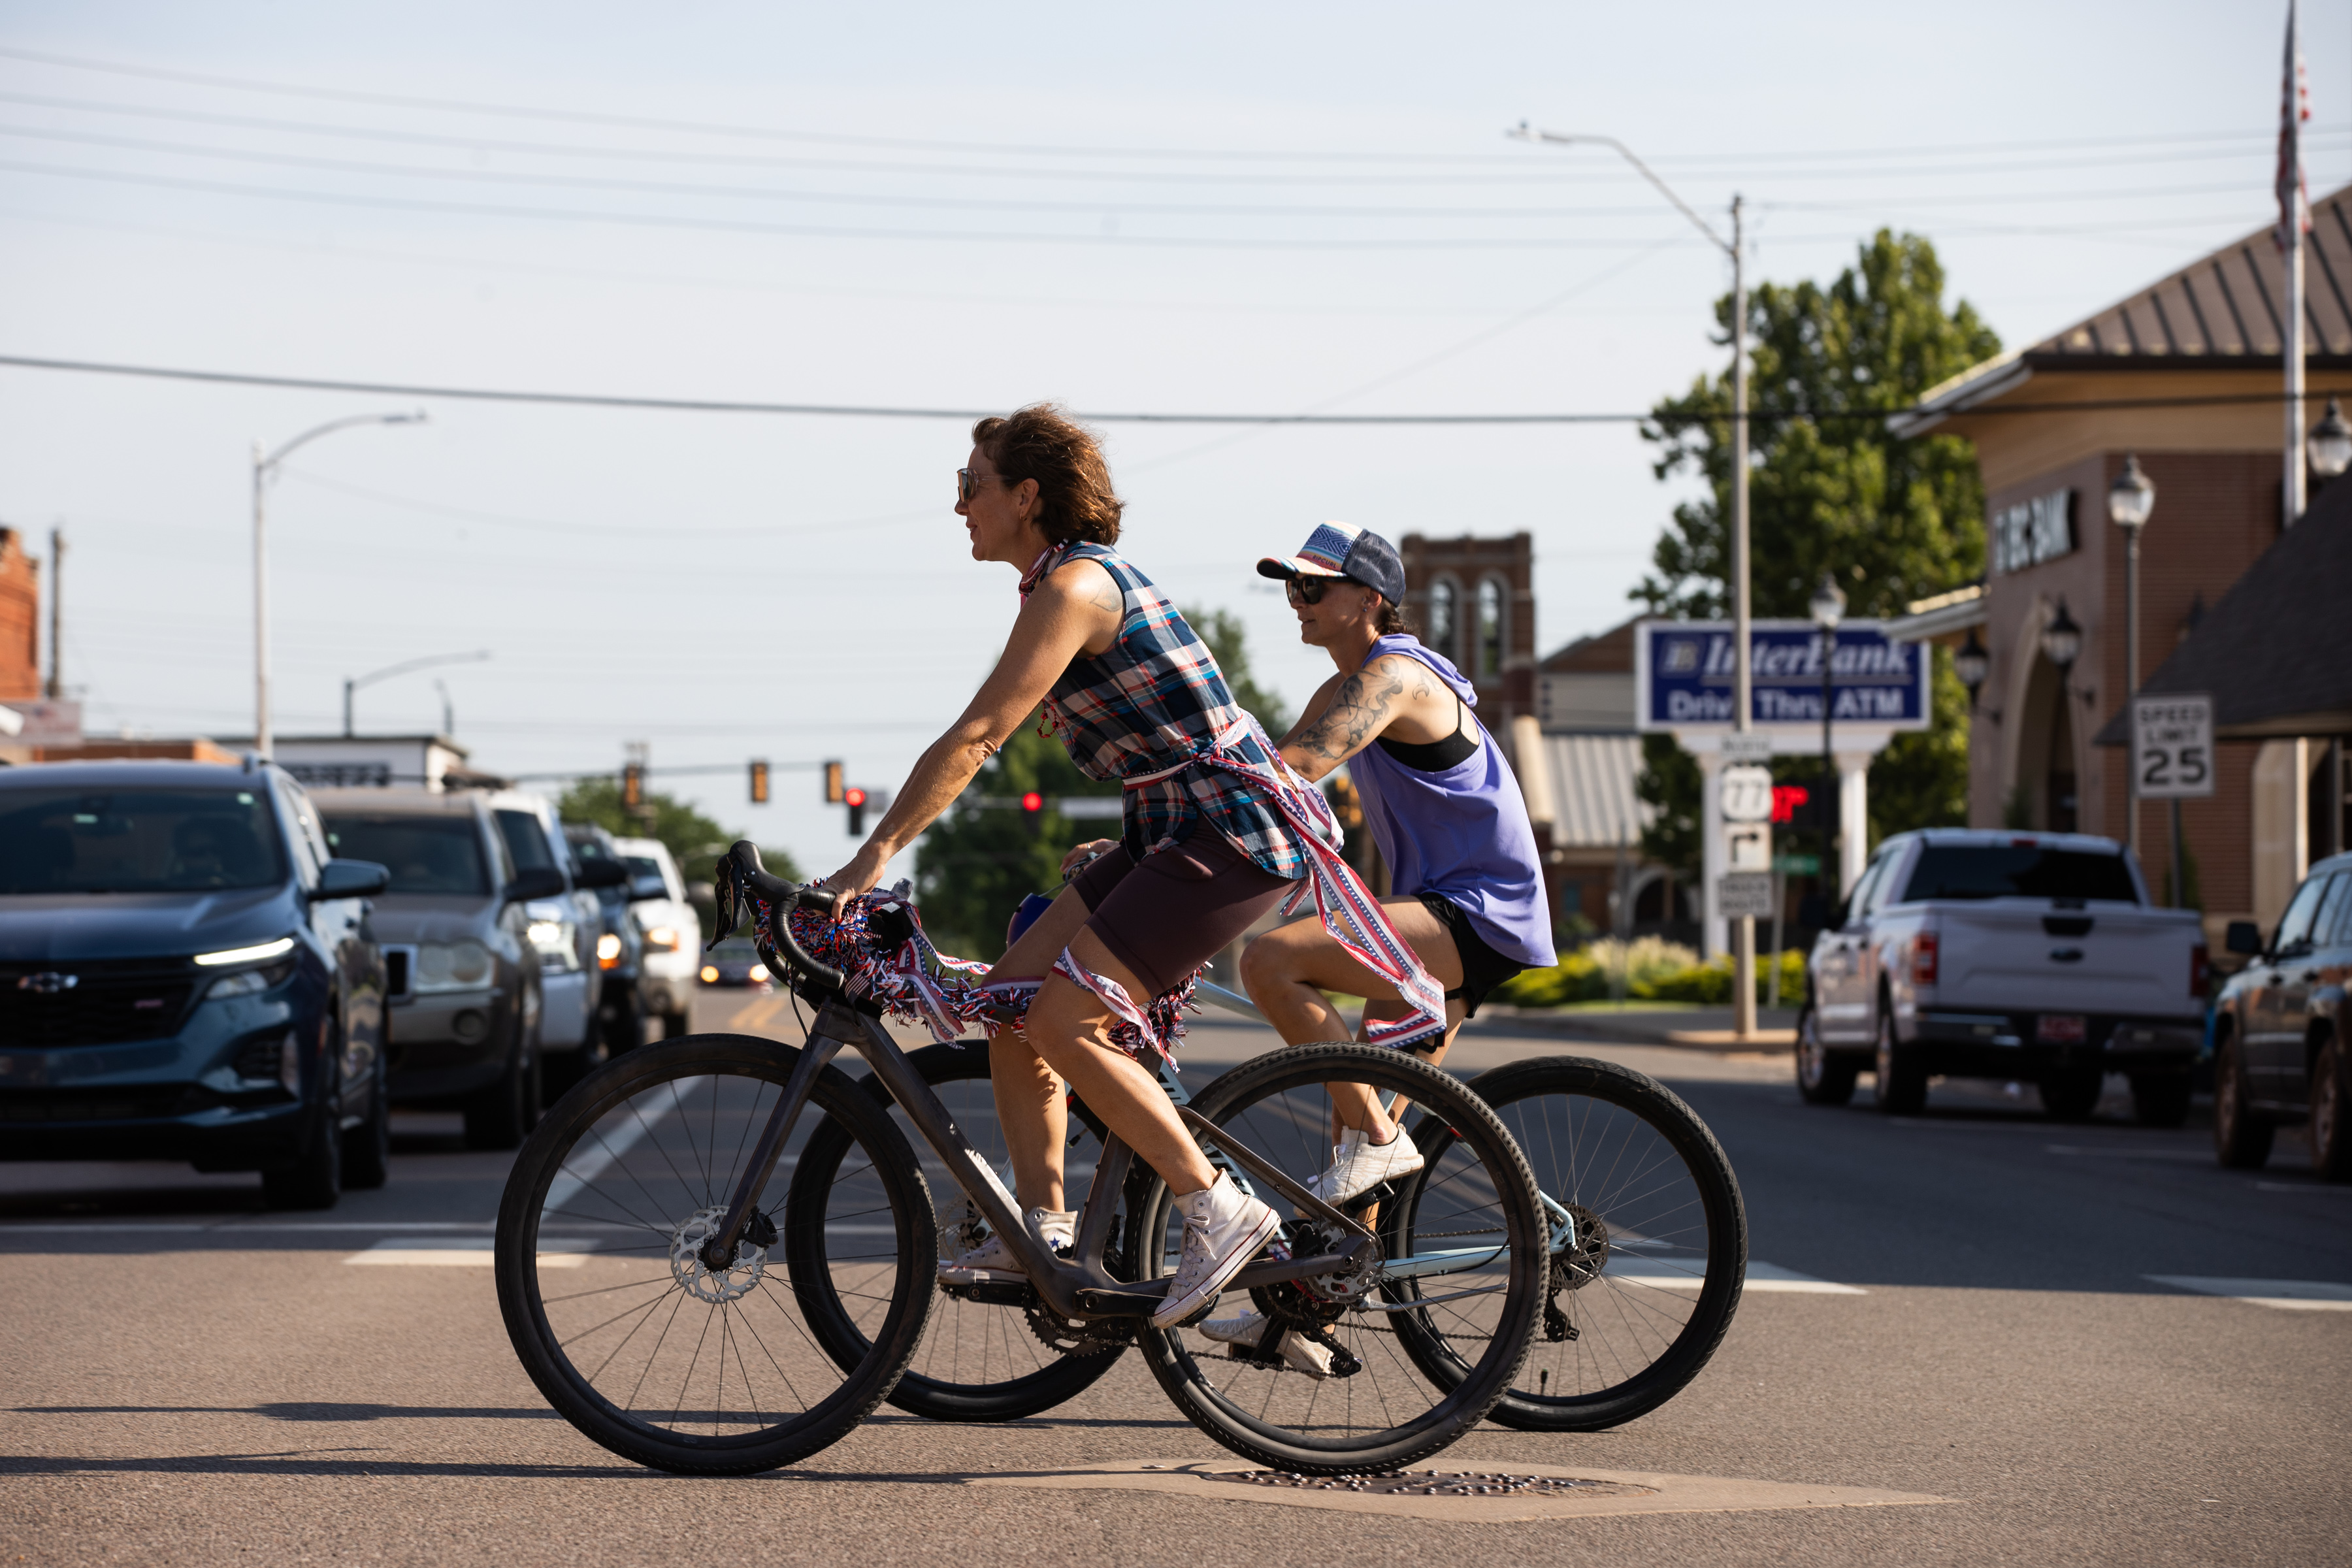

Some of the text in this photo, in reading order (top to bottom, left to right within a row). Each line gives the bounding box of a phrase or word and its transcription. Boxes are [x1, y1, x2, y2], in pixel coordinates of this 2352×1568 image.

[1668, 689, 1736, 719] Driv
[1833, 688, 1904, 718] ATM
[2141, 705, 2204, 723] SPEED
[2144, 747, 2207, 785] 25
[1730, 779, 1766, 811] 77
